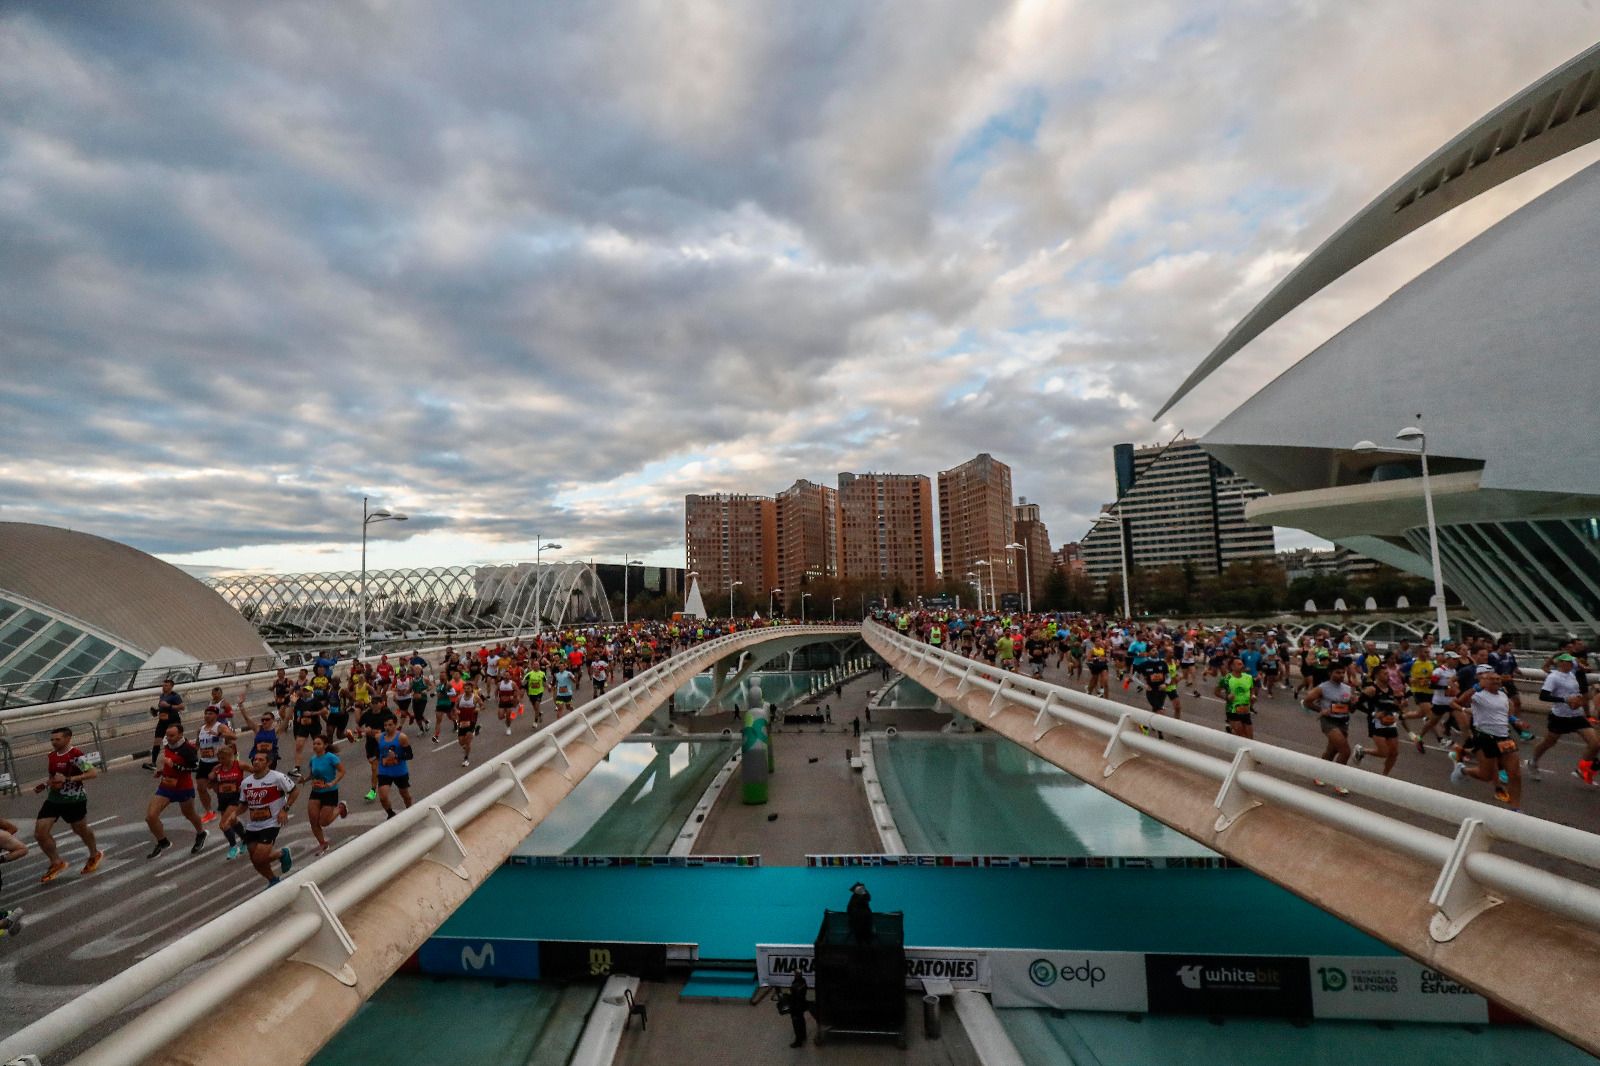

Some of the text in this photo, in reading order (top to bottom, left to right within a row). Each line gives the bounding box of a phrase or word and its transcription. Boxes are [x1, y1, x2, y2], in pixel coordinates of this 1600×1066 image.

[773, 957, 973, 977] MARA RATONES
[1061, 959, 1106, 987] edp
[1205, 967, 1280, 983] whitebit
[1352, 975, 1398, 985] TRINIDAD
[1353, 984, 1399, 993] ALFONSO
